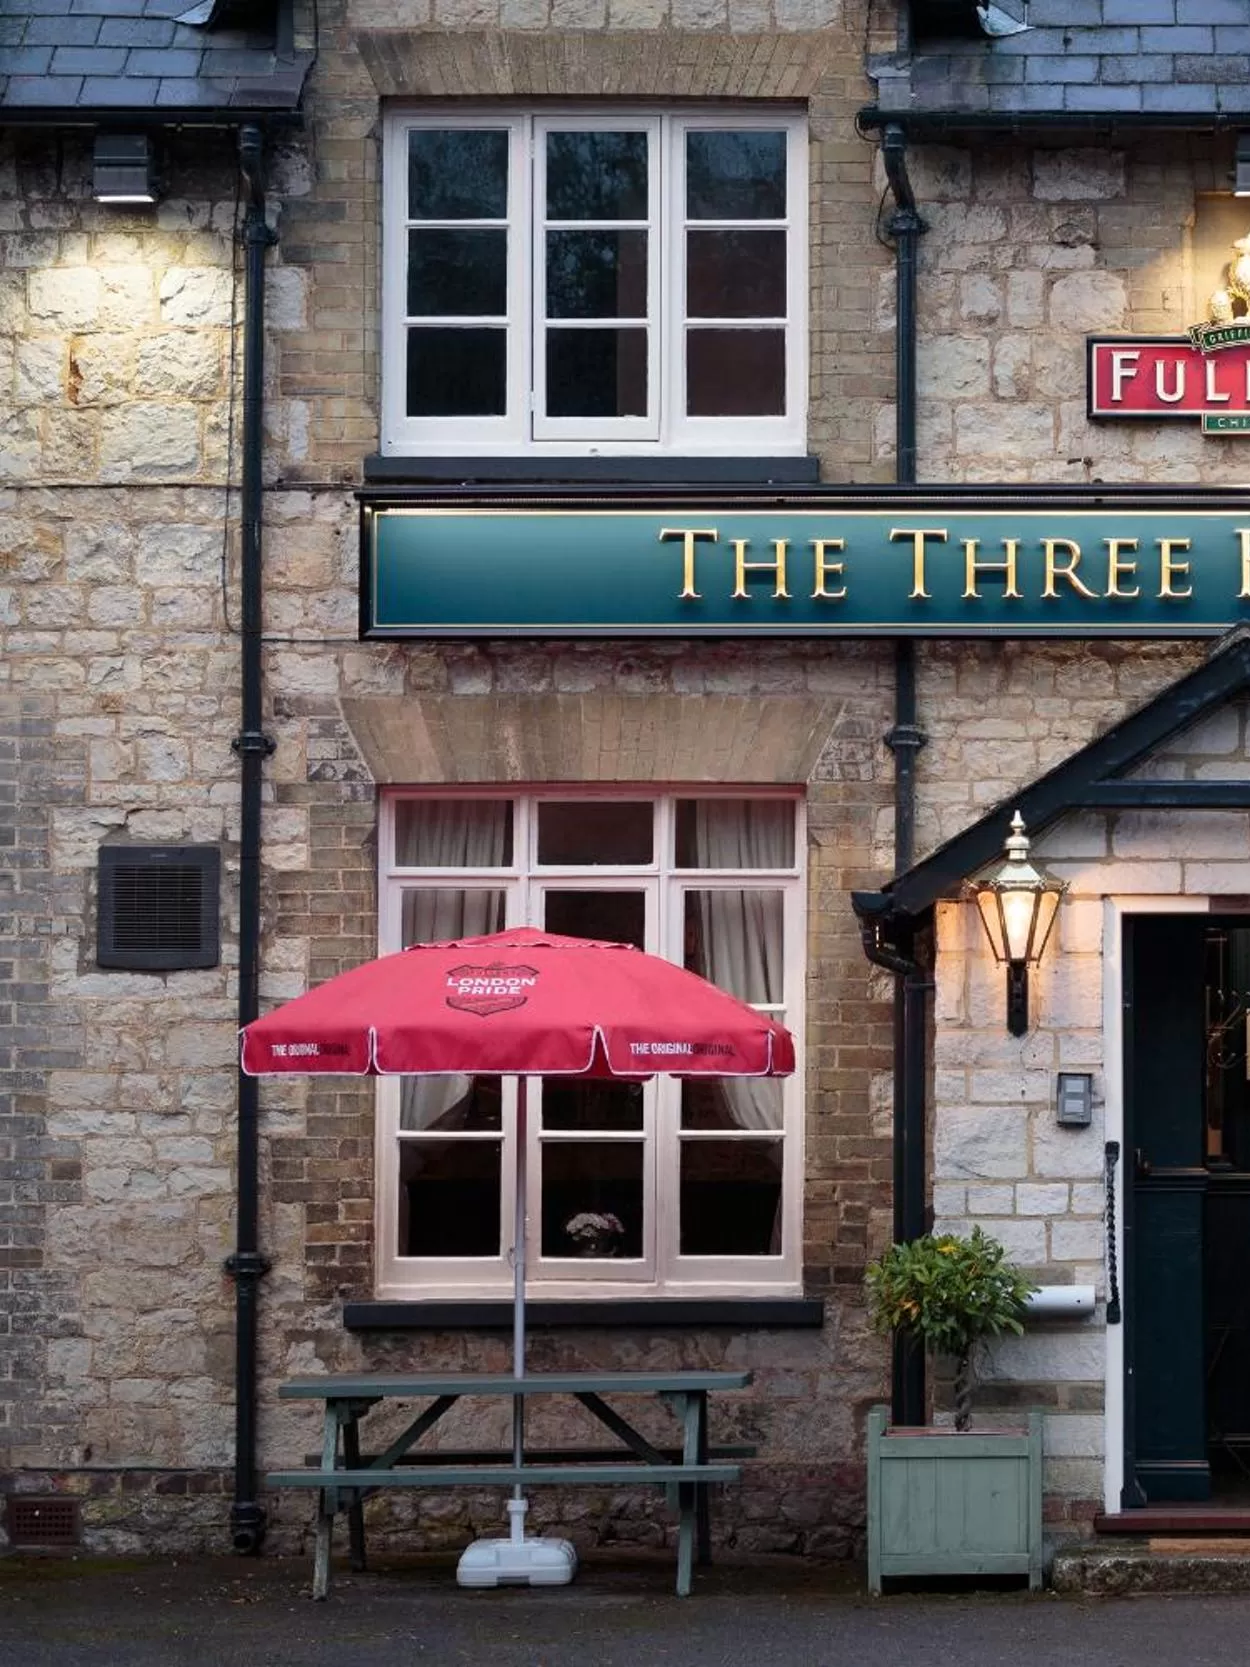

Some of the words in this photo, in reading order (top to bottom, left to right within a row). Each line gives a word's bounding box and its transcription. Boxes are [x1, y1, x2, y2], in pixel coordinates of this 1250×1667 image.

[658, 527, 848, 599] THE
[888, 527, 1193, 599] THREE
[446, 977, 537, 987] LONDON
[457, 986, 522, 995] PRIDE
[629, 1043, 650, 1055] THE
[651, 1042, 694, 1055] ORIGINAL
